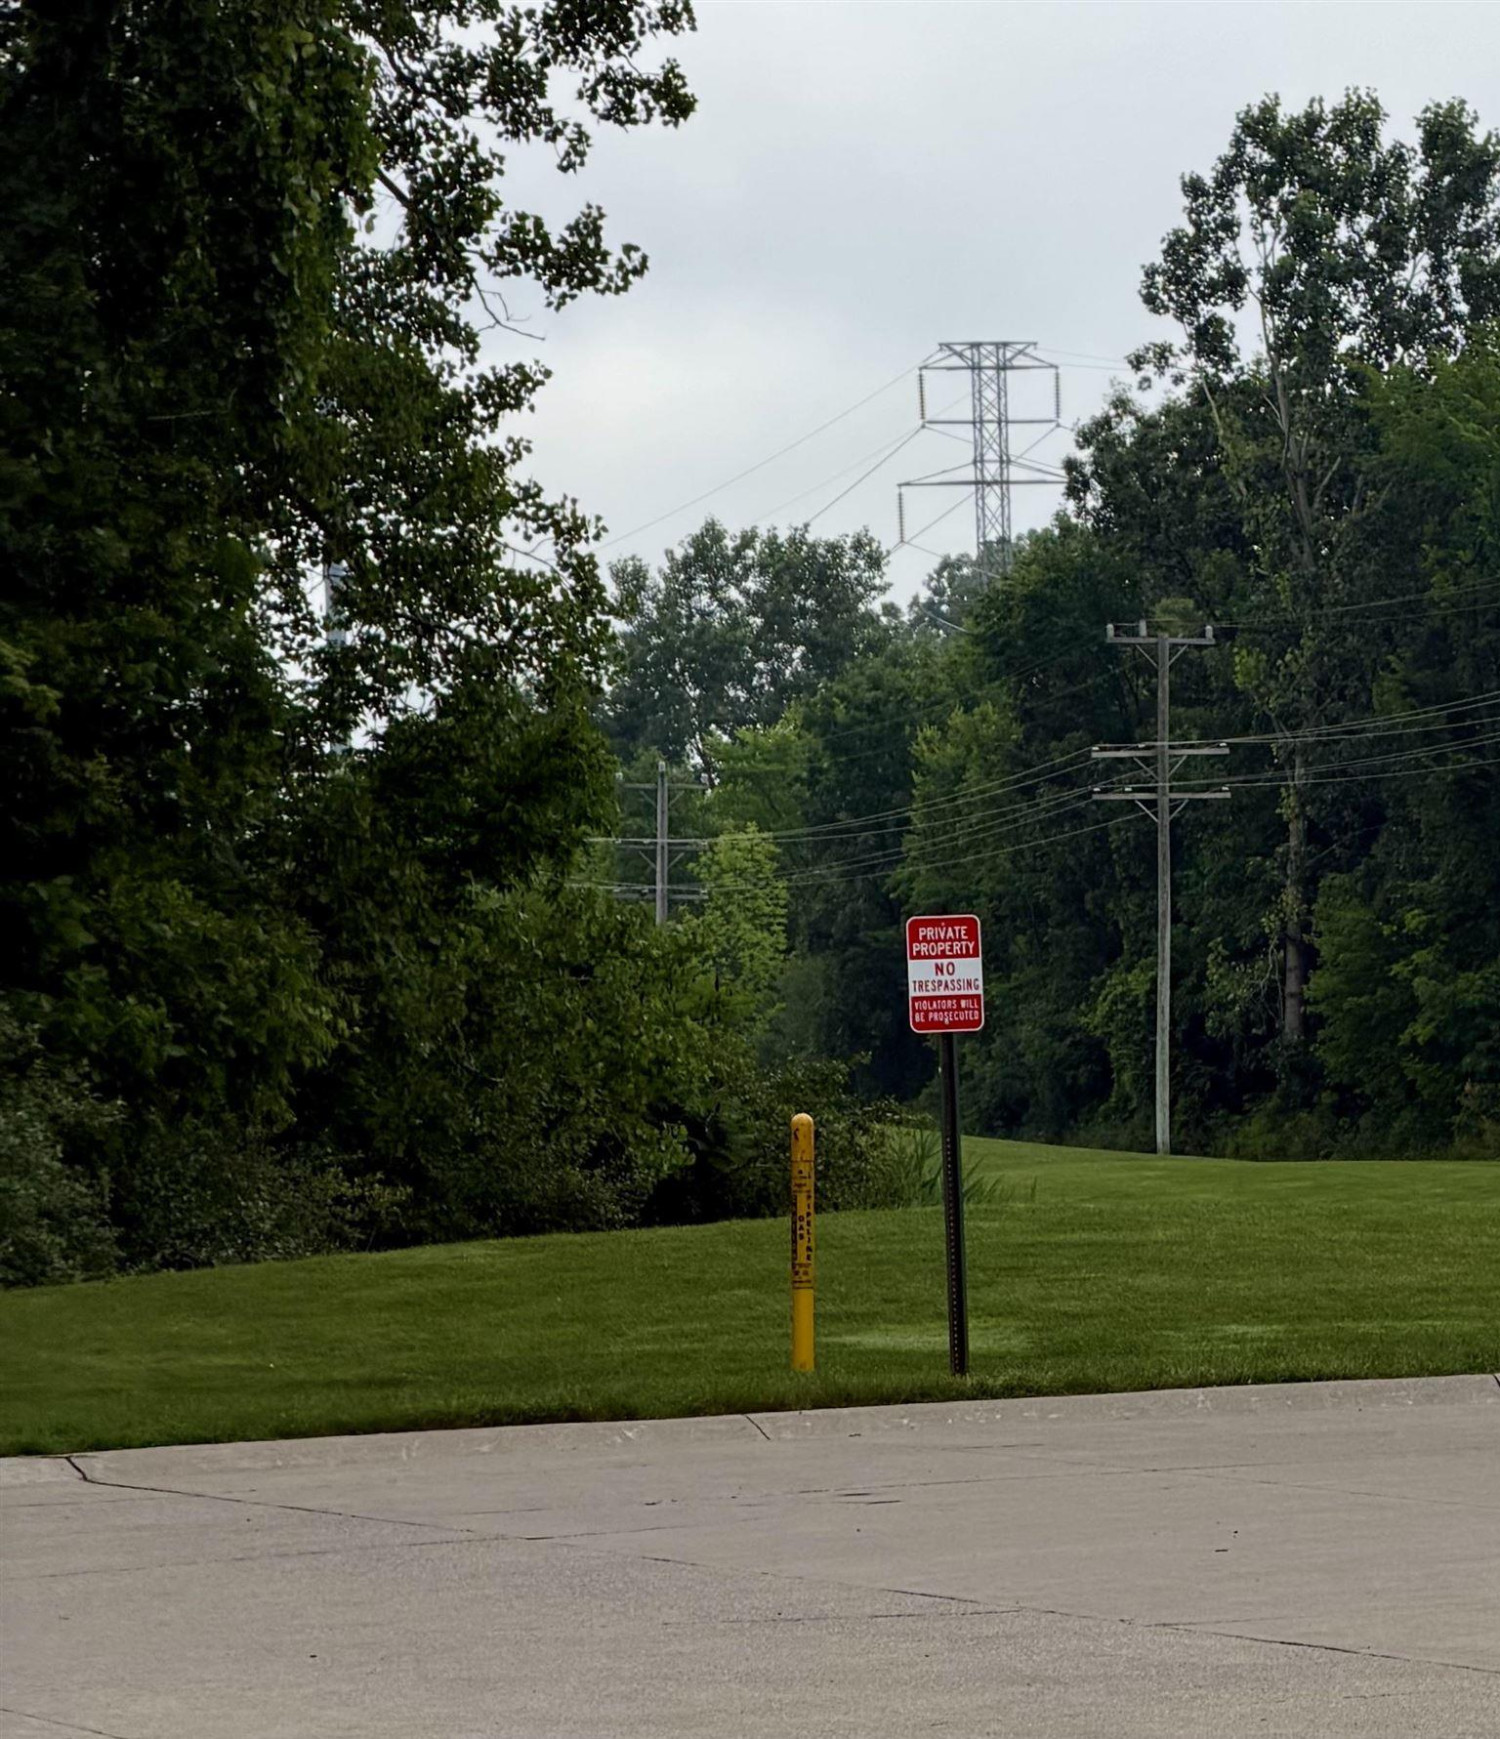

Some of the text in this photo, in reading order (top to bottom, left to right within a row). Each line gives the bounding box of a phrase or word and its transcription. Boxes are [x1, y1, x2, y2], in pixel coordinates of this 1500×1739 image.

[918, 926, 969, 941] PRIVATE
[912, 941, 975, 956] PROPERTY
[934, 962, 955, 976] NO
[912, 979, 980, 992] TRESPASSING
[914, 999, 979, 1010] VIOLATORS WILL
[914, 1010, 979, 1022] BE PROSECUTED
